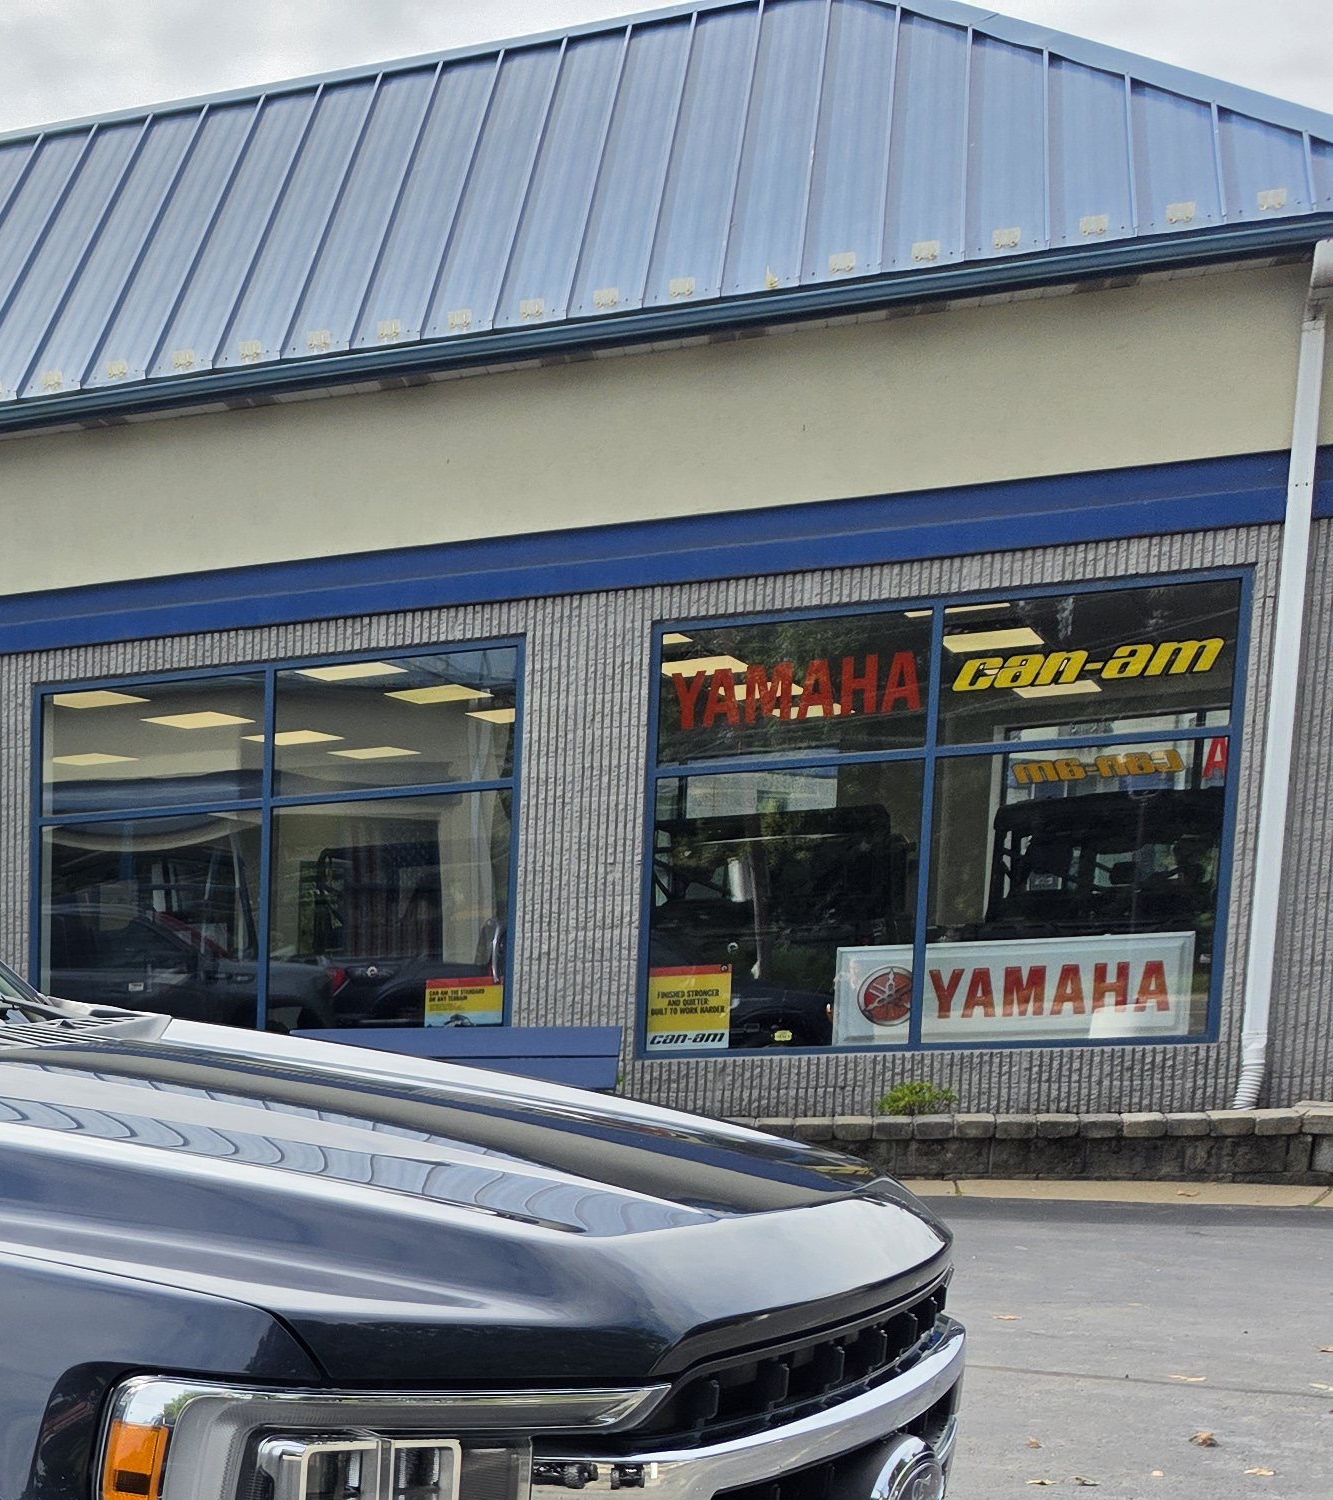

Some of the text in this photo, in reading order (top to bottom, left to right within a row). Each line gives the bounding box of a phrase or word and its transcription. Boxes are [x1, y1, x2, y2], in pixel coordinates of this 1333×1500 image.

[952, 636, 1224, 692] can-am
[672, 651, 922, 729] YAMAHA
[667, 999, 681, 1007] AND
[687, 989, 720, 997] STRONGER
[928, 960, 1171, 1019] YAMAHA
[670, 1007, 678, 1015] TO
[680, 1006, 698, 1014] WORK
